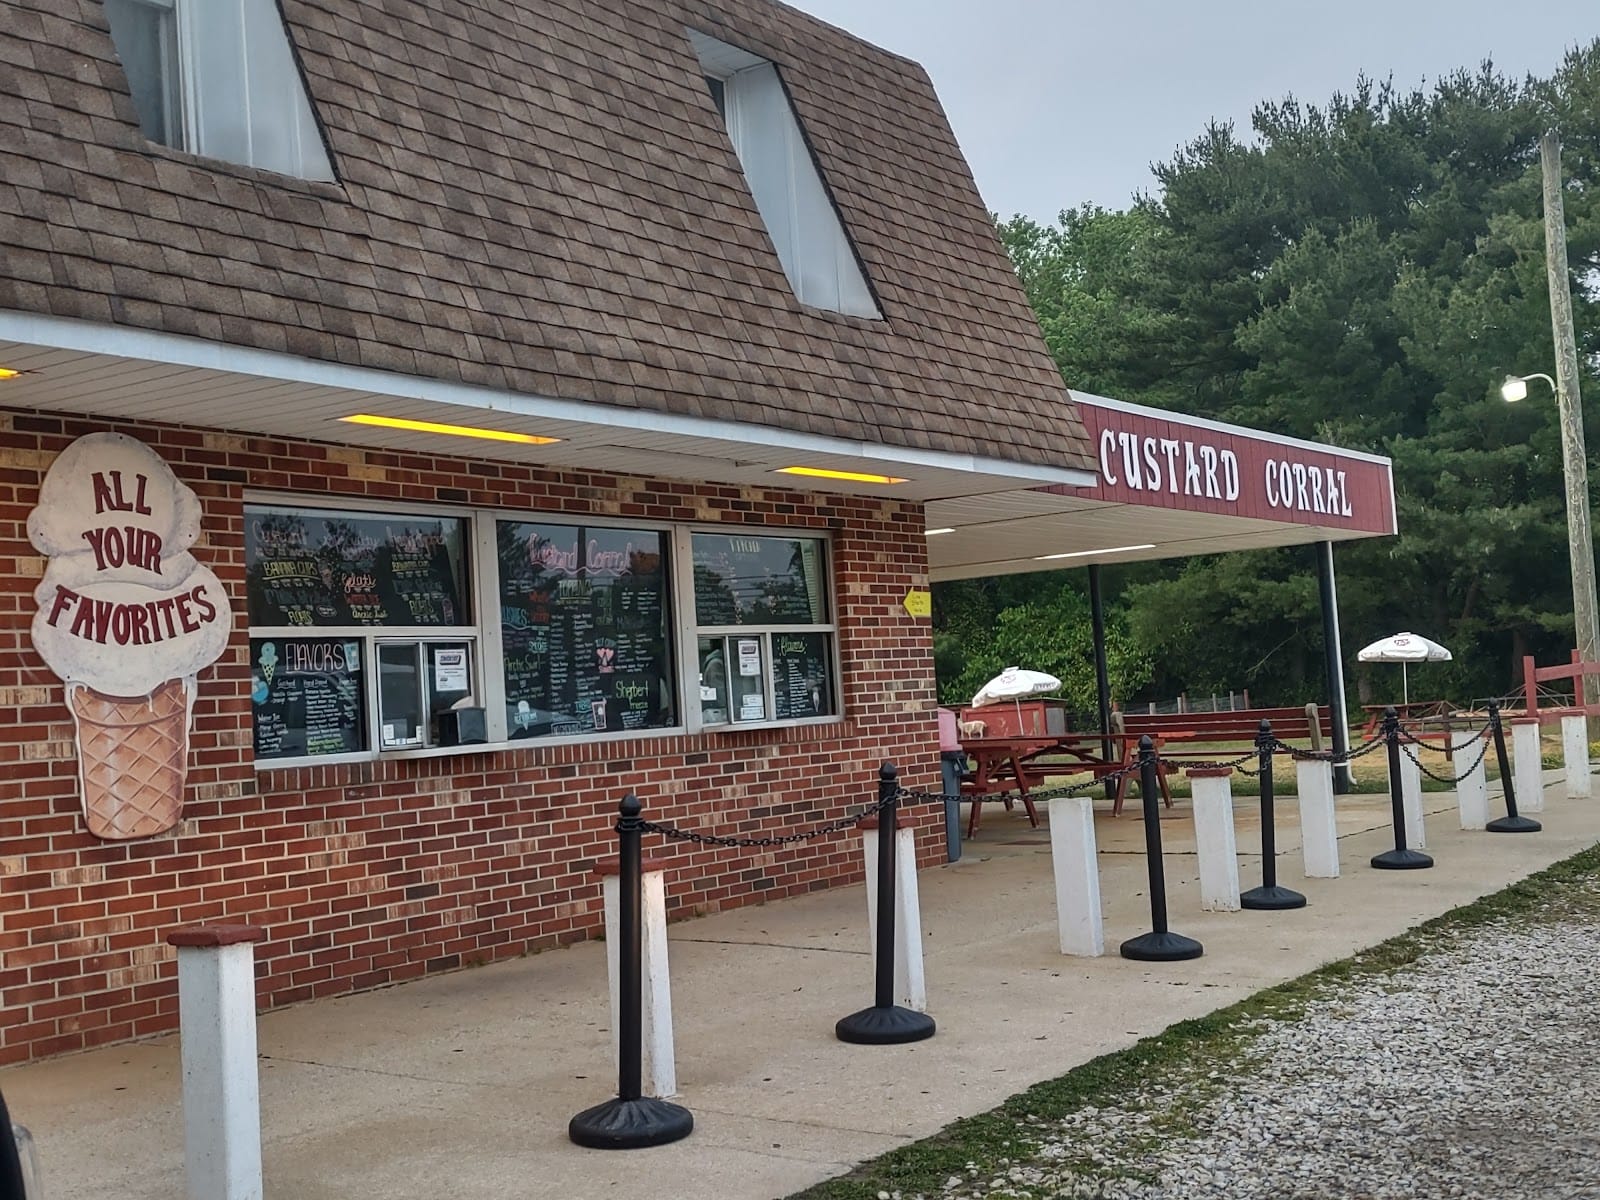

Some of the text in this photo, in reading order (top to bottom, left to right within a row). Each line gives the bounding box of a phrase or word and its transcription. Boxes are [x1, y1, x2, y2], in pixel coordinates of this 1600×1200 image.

[91, 470, 152, 516] ALL
[1100, 428, 1353, 517] CUSTARD CORRAL
[82, 526, 162, 575] YOUR
[586, 539, 632, 571] Corral
[47, 584, 216, 645] FAVORITES
[285, 643, 345, 671] FLAVORS
